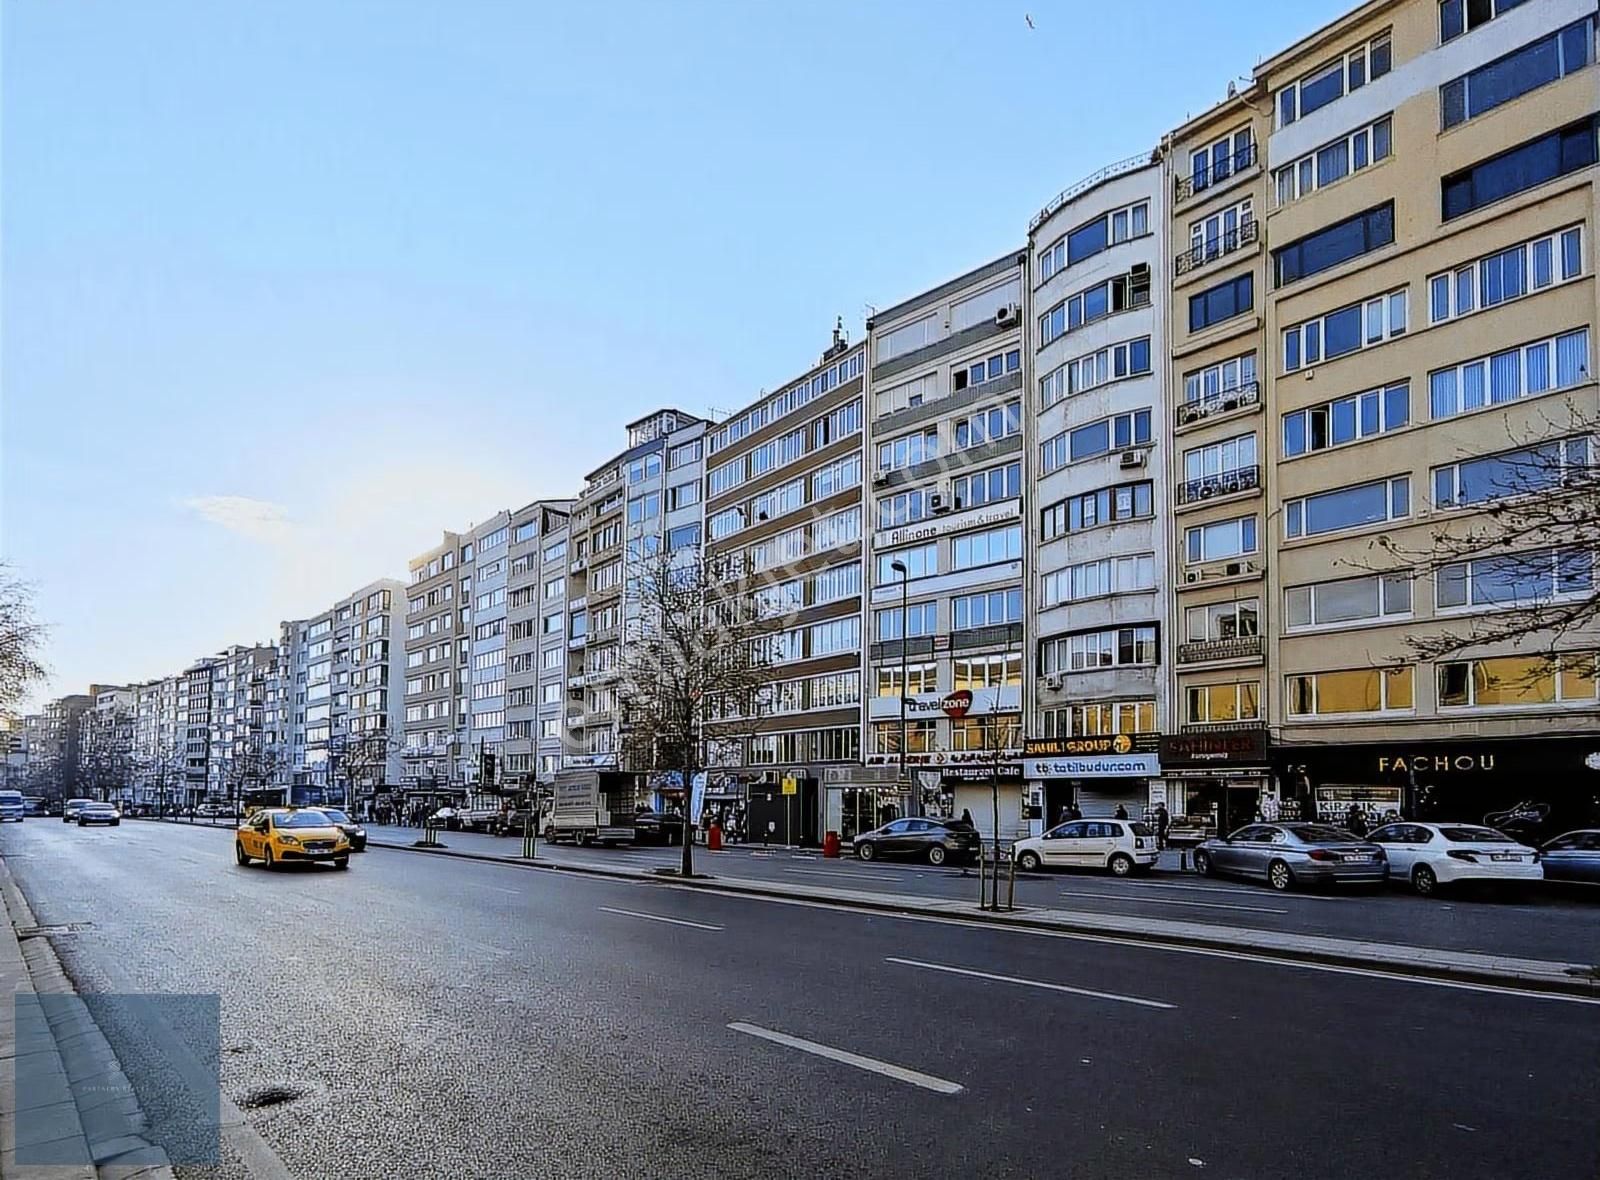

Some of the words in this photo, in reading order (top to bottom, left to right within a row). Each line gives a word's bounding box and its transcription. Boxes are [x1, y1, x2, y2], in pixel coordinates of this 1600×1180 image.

[891, 526, 937, 543] Allinone
[1066, 740, 1111, 753] GROUP
[1379, 756, 1494, 772] FACHOU
